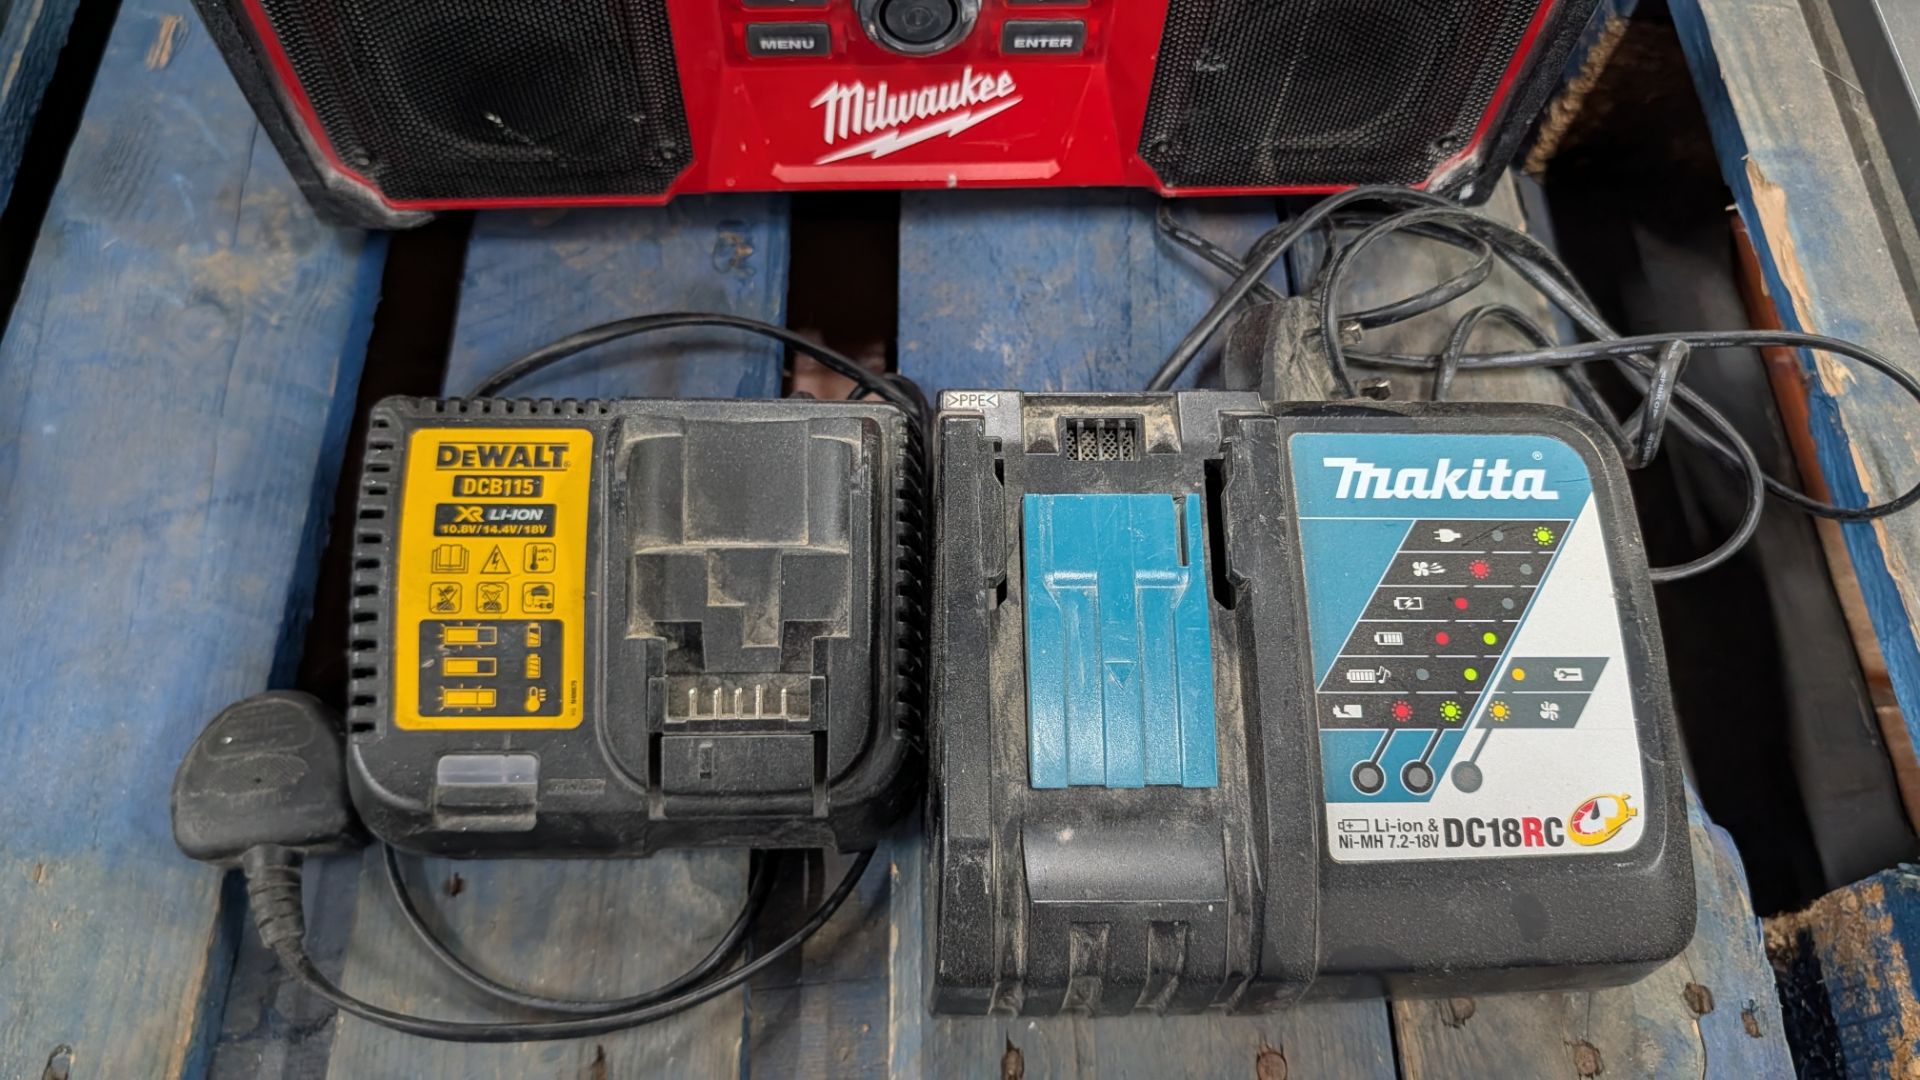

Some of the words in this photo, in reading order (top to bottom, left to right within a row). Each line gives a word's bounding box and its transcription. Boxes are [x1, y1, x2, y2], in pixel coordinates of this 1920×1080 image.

[760, 38, 815, 50] MENU
[1014, 36, 1073, 49] ENTER
[810, 65, 1017, 145] Milwaukee
[437, 445, 569, 468] DEWALT
[463, 477, 534, 495] DCB115
[454, 505, 485, 523] XR
[489, 508, 544, 521] LI-ION
[441, 524, 547, 535] 10.8V/14.4V/18V
[1375, 818, 1423, 833] Li-ion
[1428, 819, 1439, 832] &
[1443, 816, 1565, 848] DC18RC
[1338, 834, 1384, 849] Ni-MH
[1388, 833, 1440, 849] 7.2-18V
